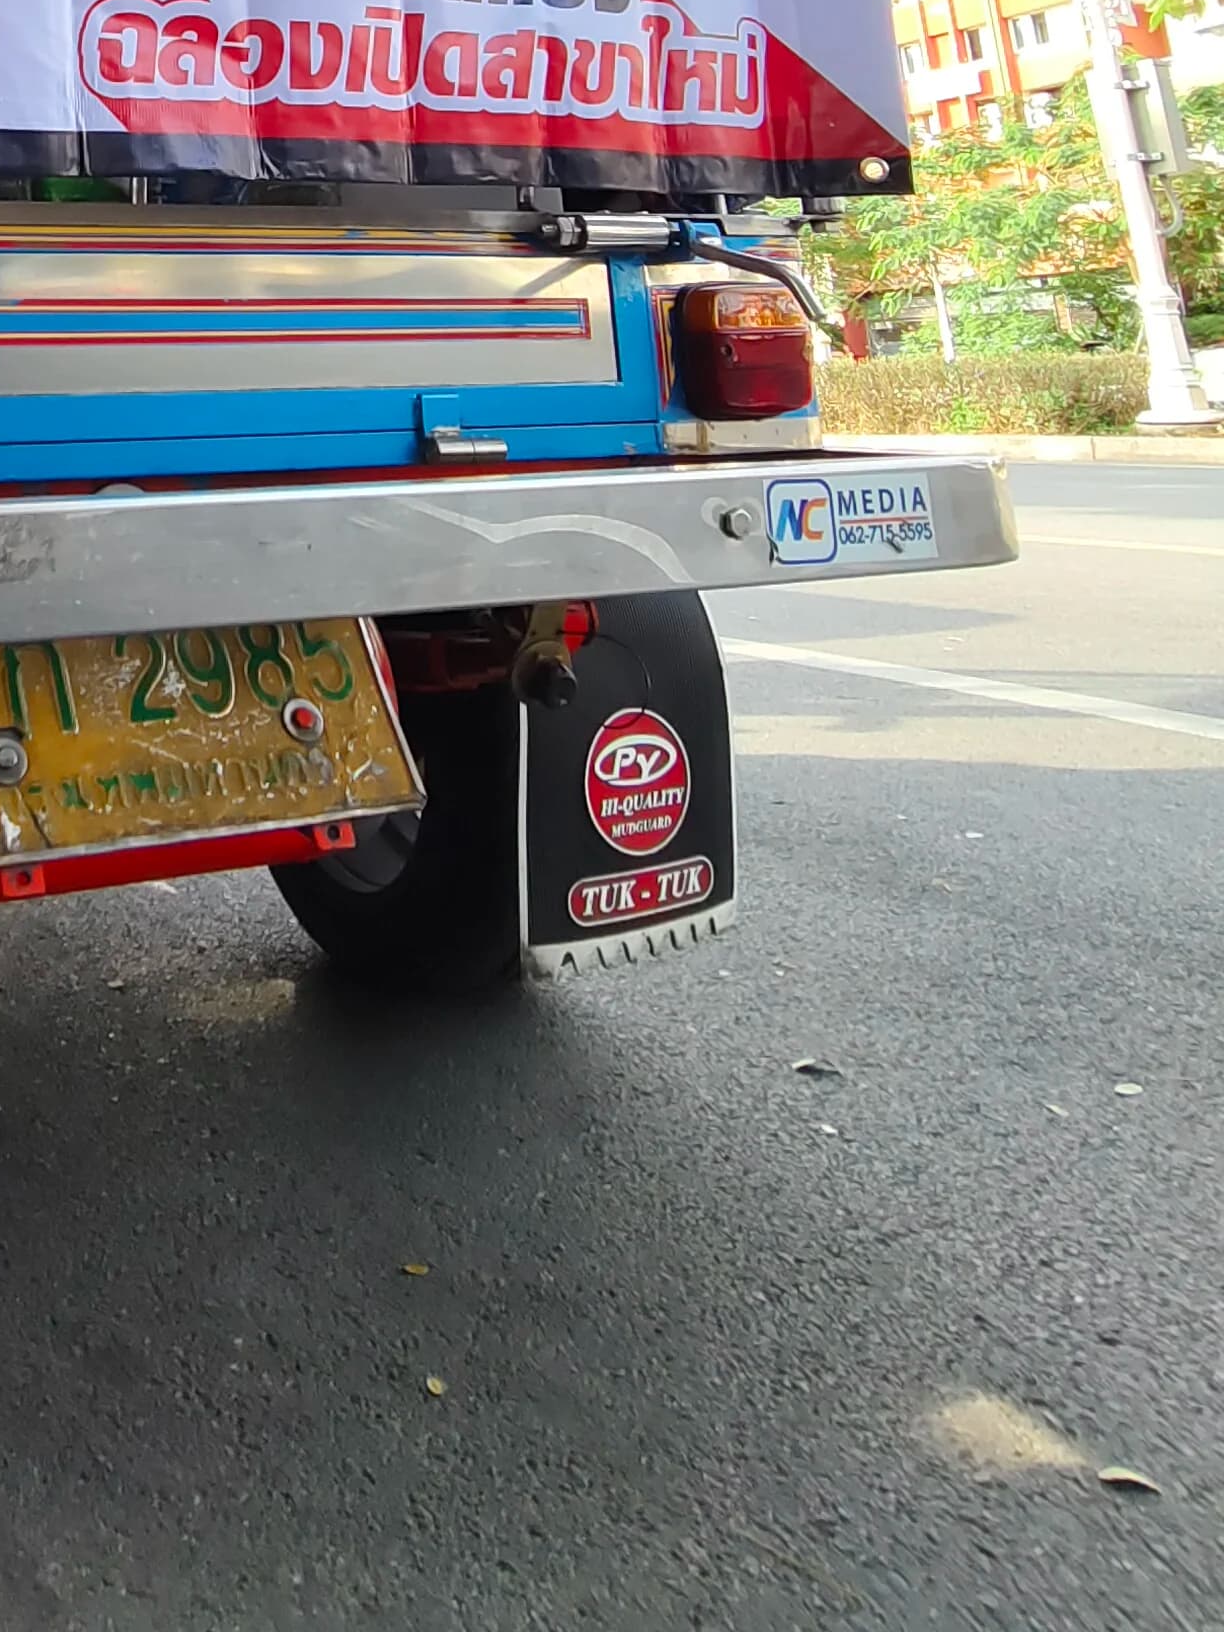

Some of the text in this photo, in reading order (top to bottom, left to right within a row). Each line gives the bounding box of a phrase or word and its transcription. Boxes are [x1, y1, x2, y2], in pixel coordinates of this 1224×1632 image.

[97, 7, 760, 116] ฉลองเปิดสาขาใหม่
[837, 486, 927, 517] MEDIA
[839, 521, 933, 545] 062-715-5595
[112, 621, 354, 724] 2985
[600, 787, 685, 818] HI-QUALITY
[610, 814, 672, 839] MUDGUARD
